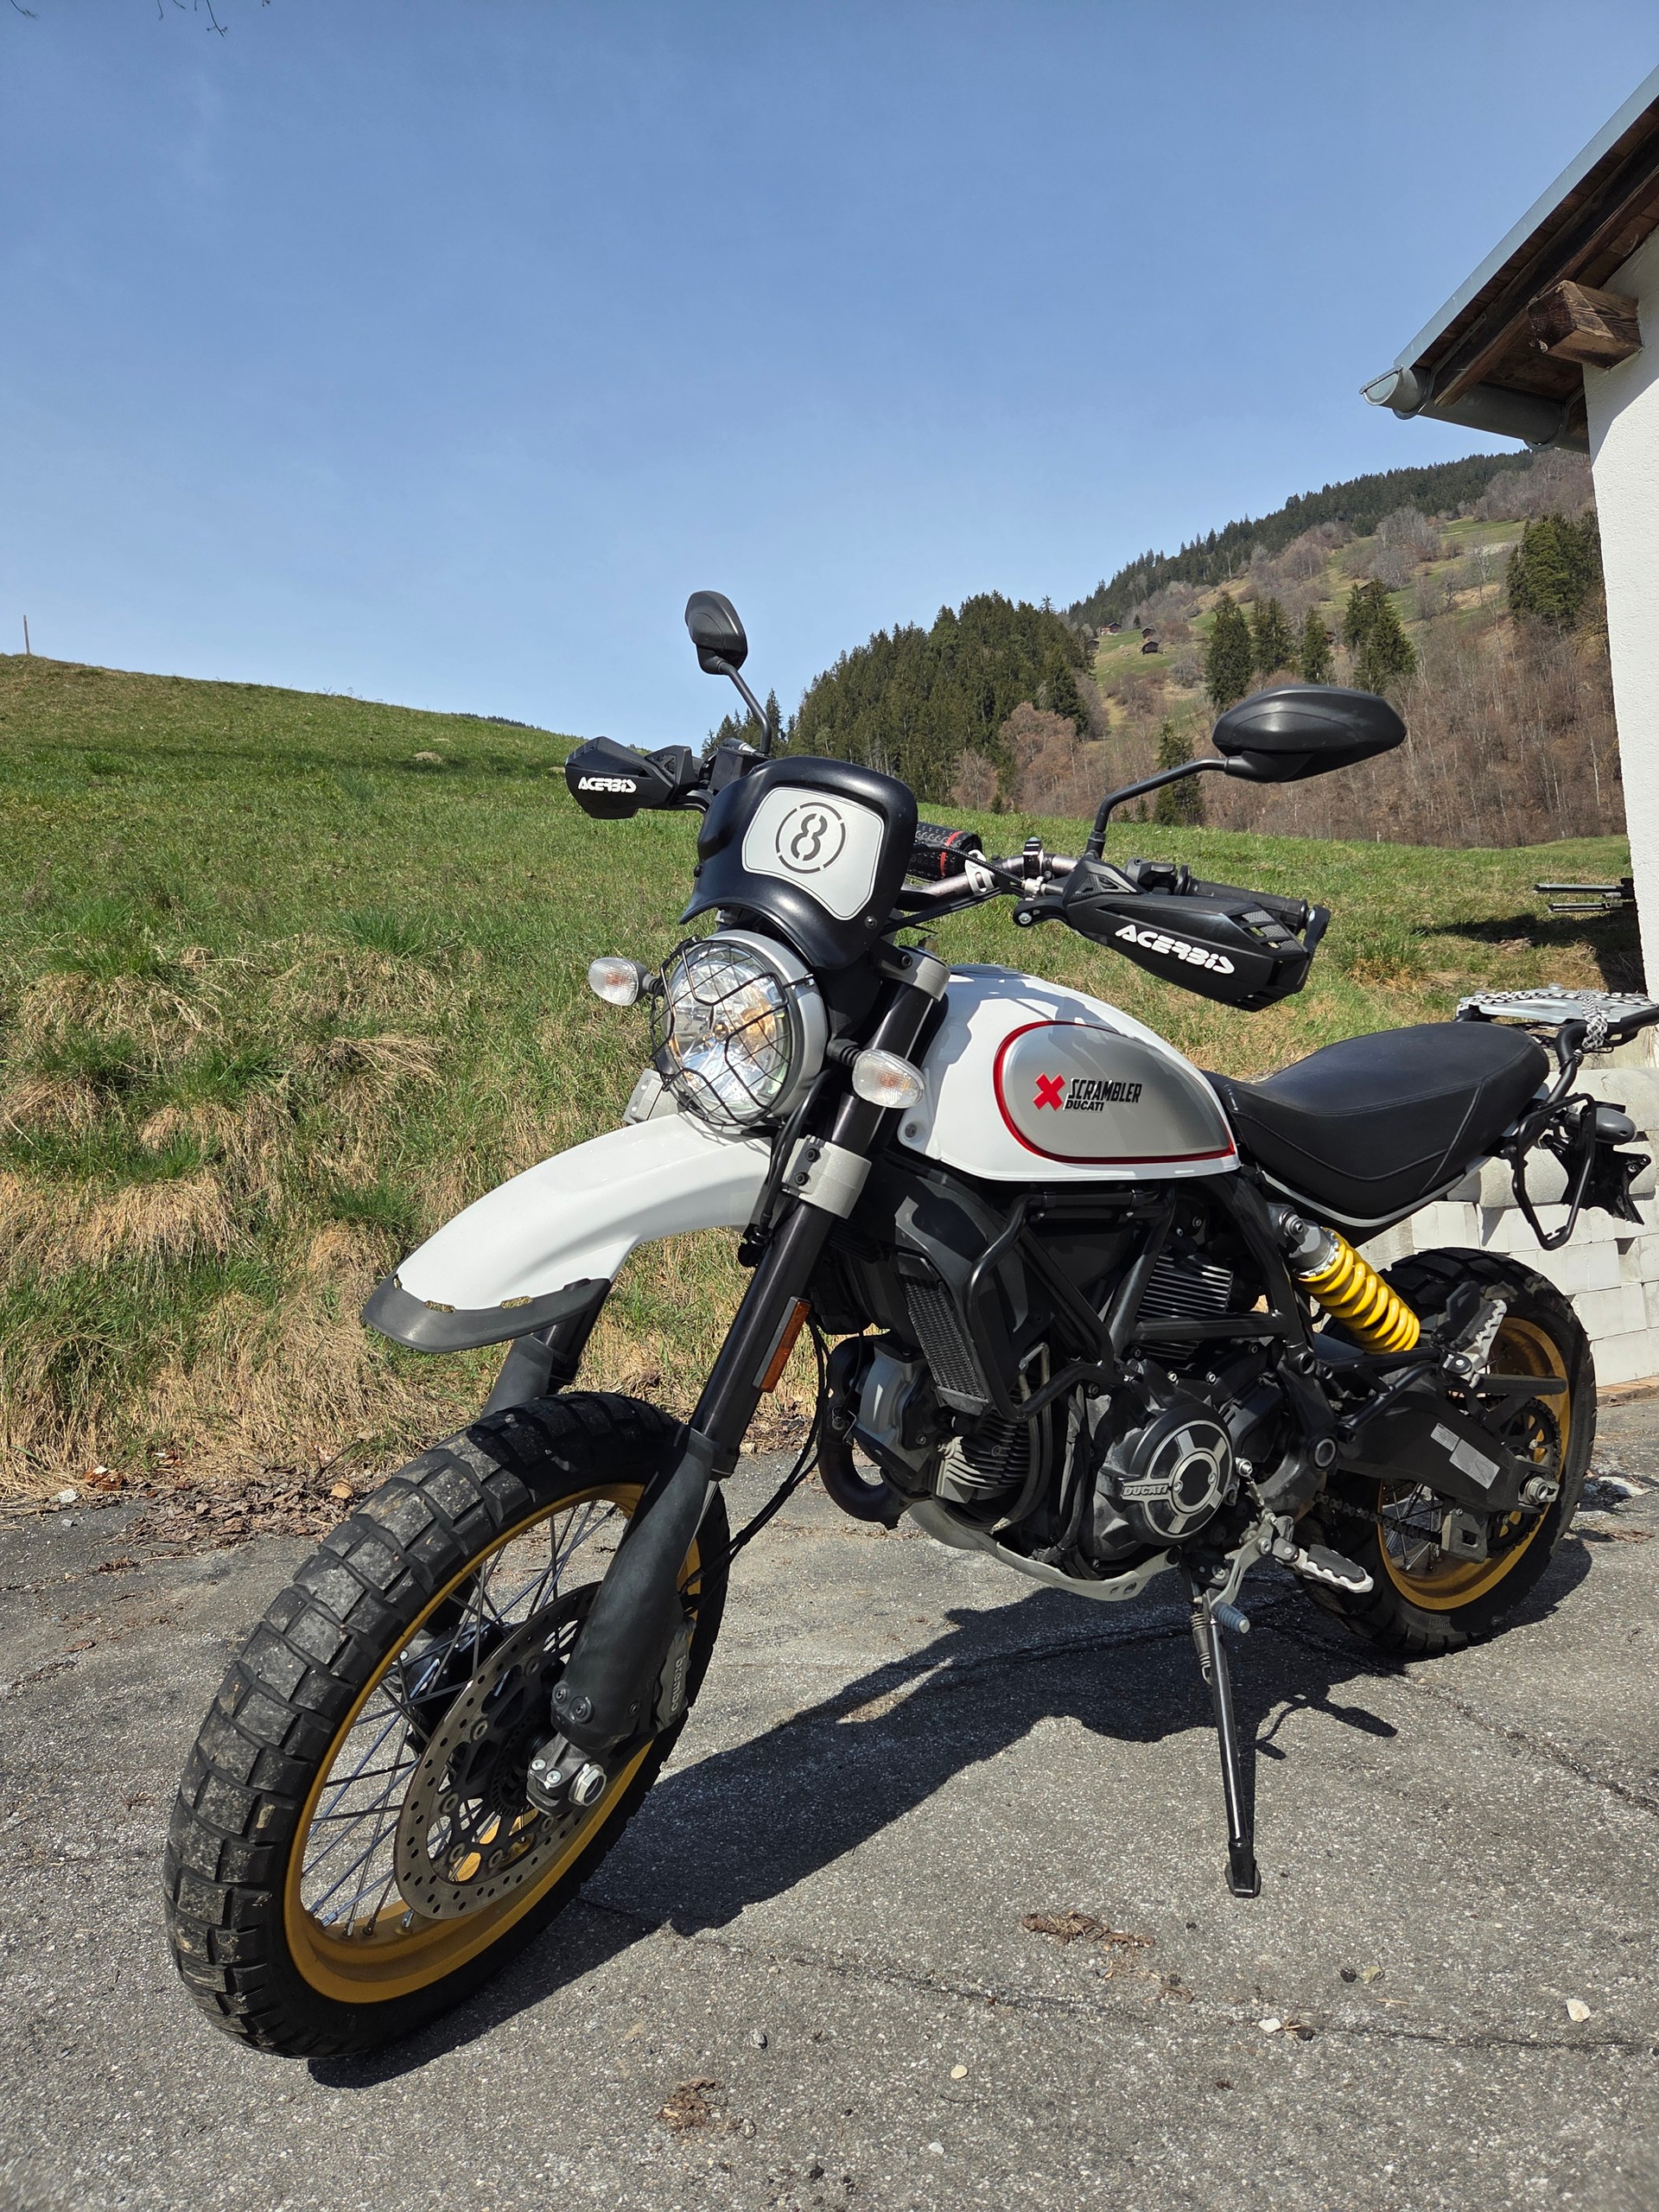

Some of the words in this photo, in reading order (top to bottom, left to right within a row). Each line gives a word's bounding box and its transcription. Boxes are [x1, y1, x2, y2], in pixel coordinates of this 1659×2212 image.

[578, 776, 637, 794] ACERBIS
[791, 813, 828, 861] 8
[1115, 924, 1236, 975] ACERBIS
[1067, 1078, 1142, 1103] SCRAMBLER
[1065, 1100, 1104, 1111] DUCATI
[1122, 1484, 1168, 1496] DUCATI
[671, 1654, 686, 1712] brembo
